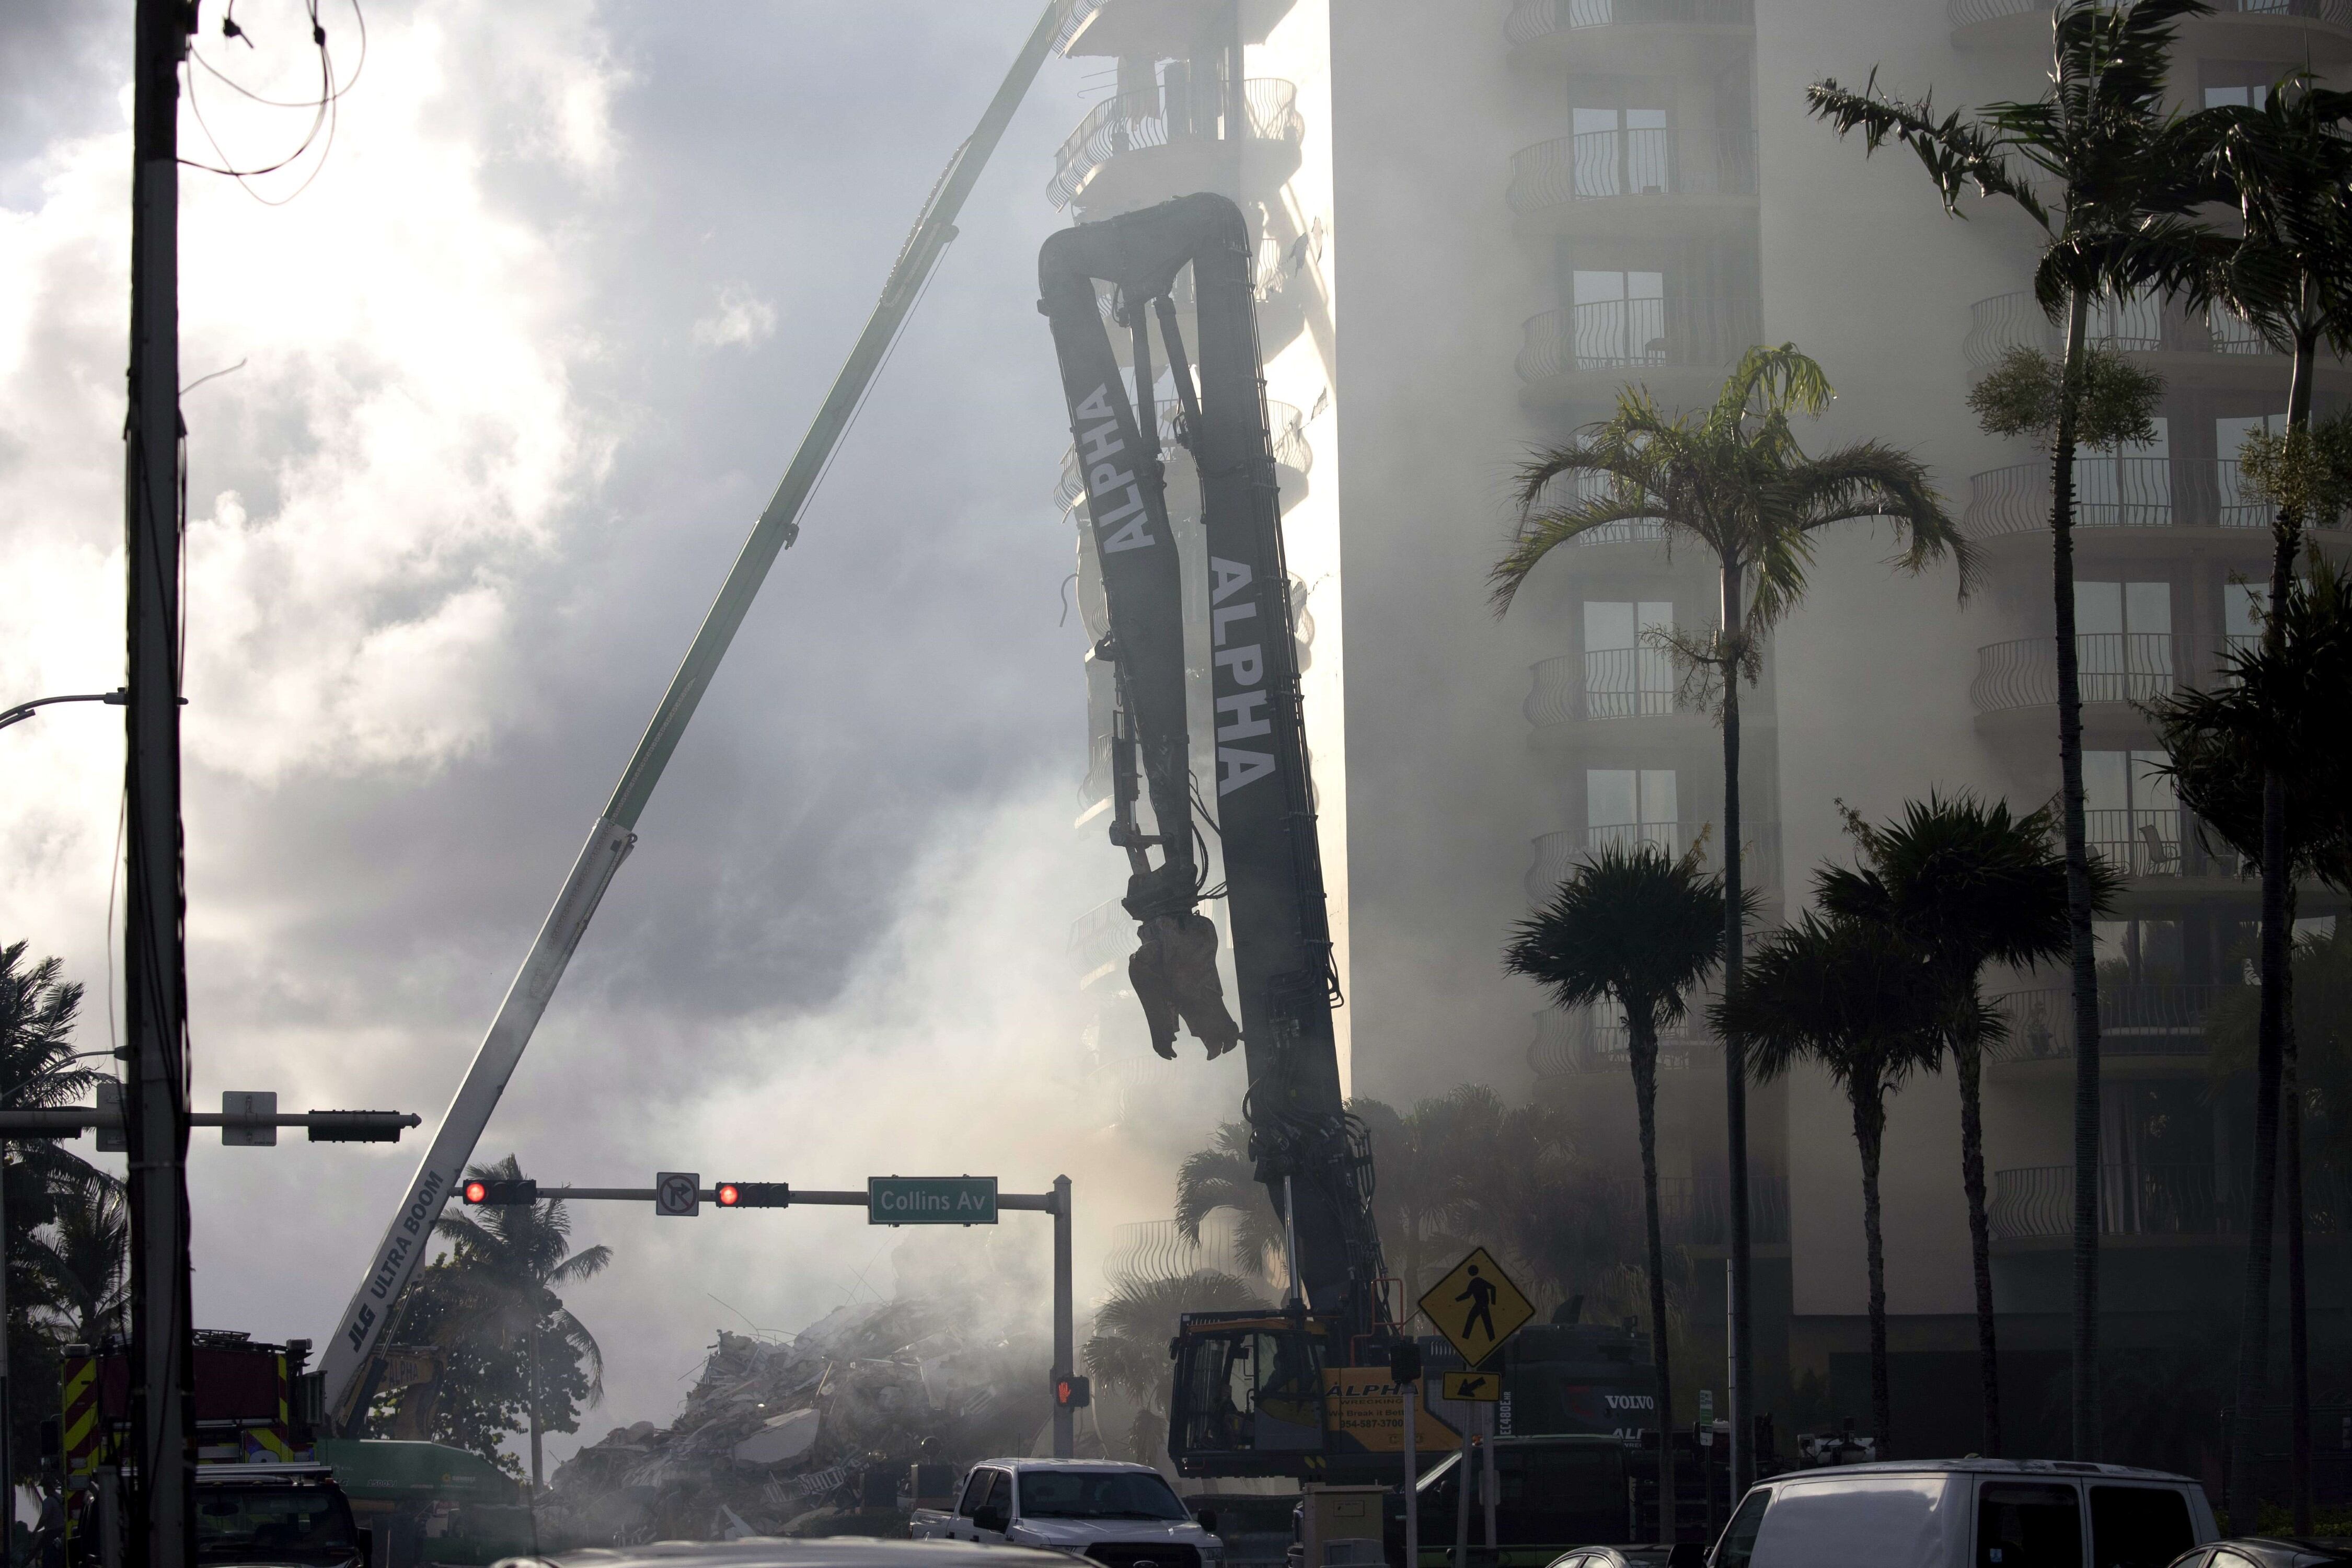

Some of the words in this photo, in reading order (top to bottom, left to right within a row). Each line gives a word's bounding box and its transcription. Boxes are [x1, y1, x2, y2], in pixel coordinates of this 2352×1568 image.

[1076, 382, 1156, 554] ALPHA
[1210, 555, 1276, 798] ALPHA
[881, 1191, 950, 1210] Collins
[957, 1191, 986, 1210] Av
[349, 1304, 376, 1353] JLG
[371, 1236, 412, 1299] ULTRA
[403, 1170, 443, 1235] BOOM
[389, 1358, 419, 1388] ALPHA
[1605, 1395, 1654, 1410] VOLVO
[1340, 1419, 1404, 1428] 954-587-3700
